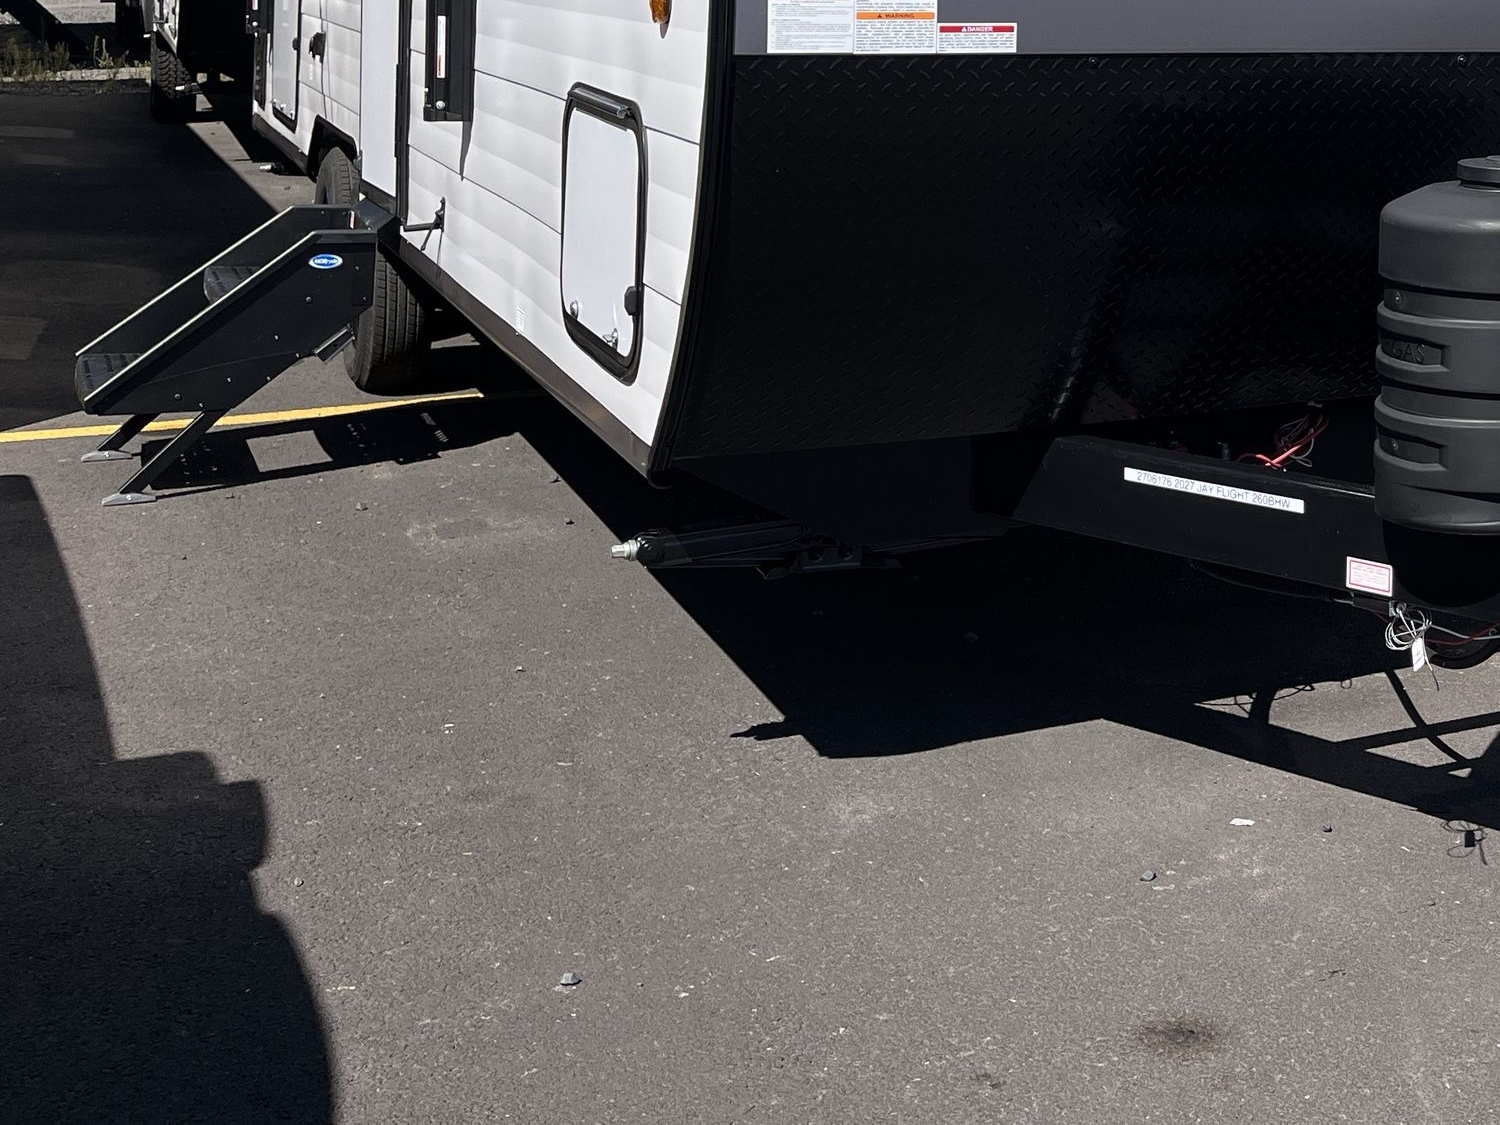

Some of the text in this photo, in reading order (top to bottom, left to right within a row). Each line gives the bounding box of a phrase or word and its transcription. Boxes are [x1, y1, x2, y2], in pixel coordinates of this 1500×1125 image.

[1174, 478, 1195, 491] 2027
[1197, 483, 1213, 493] JAY
[1216, 486, 1249, 501] FLIGHT
[1252, 493, 1291, 508] 260BHW
